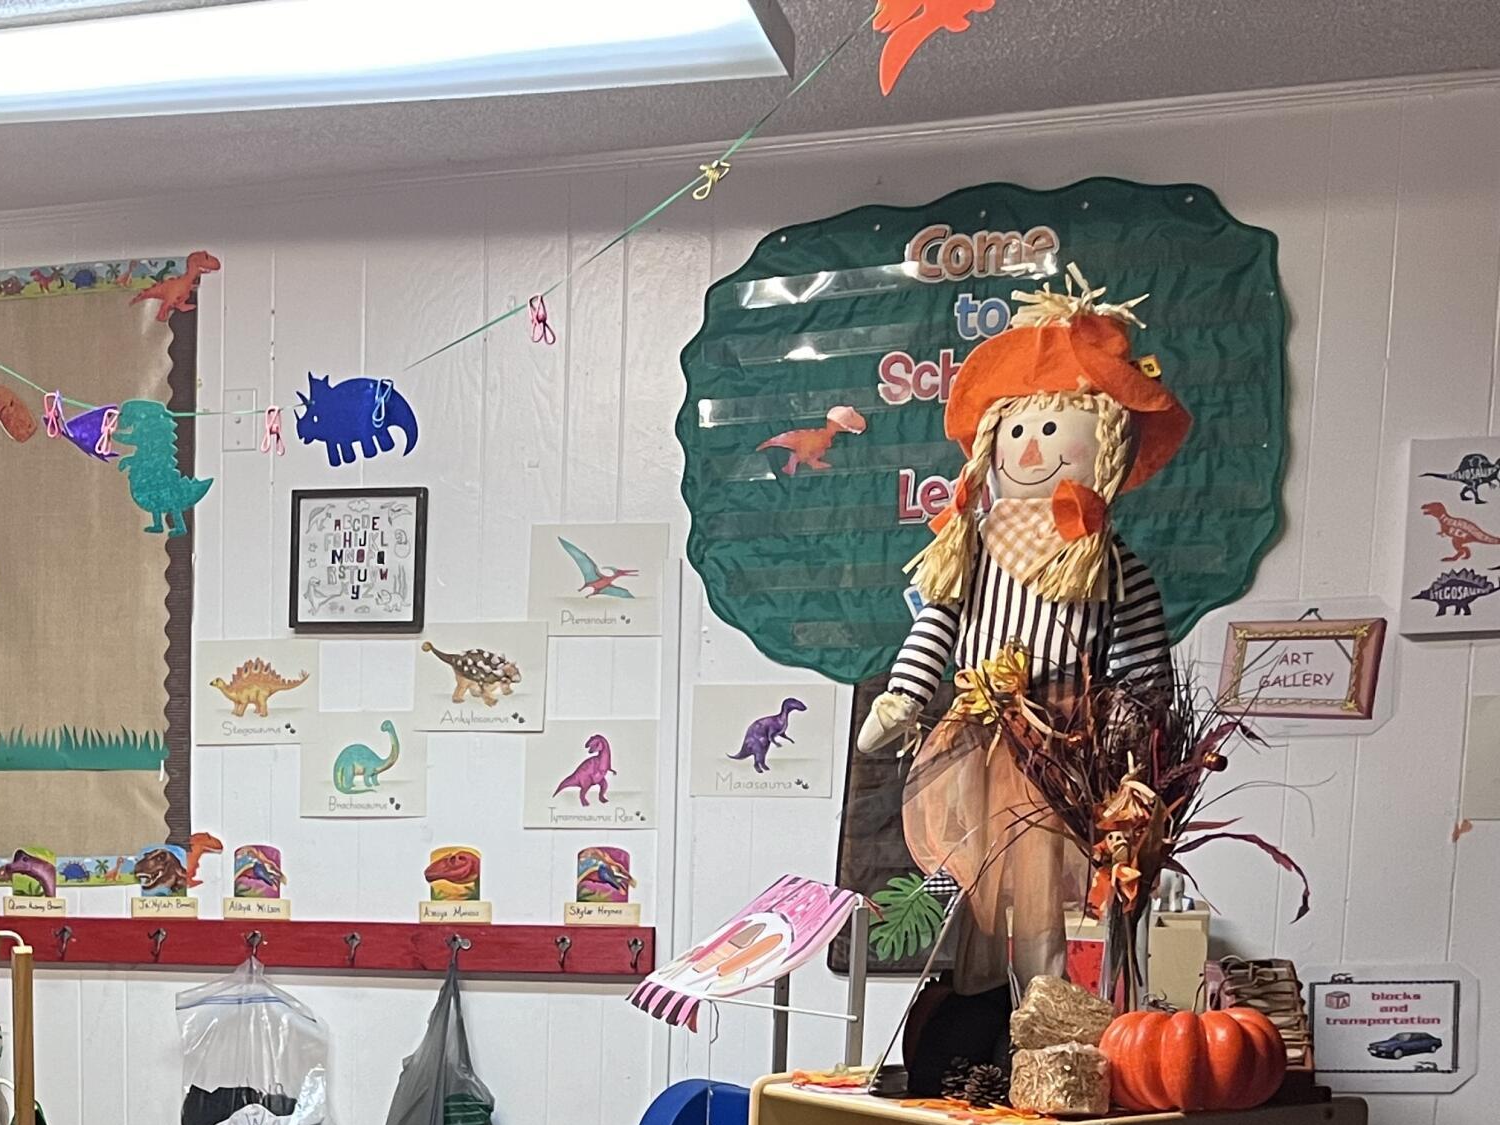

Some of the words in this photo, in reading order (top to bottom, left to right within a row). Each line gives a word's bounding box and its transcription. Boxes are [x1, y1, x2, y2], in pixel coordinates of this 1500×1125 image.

[908, 225, 1058, 282] Come
[954, 293, 1011, 340] to
[1279, 652, 1314, 665] ART
[1259, 672, 1335, 688] GALLERY
[1371, 991, 1421, 1001] blocks
[1379, 1004, 1409, 1013] and
[1325, 1016, 1441, 1027] transportation
